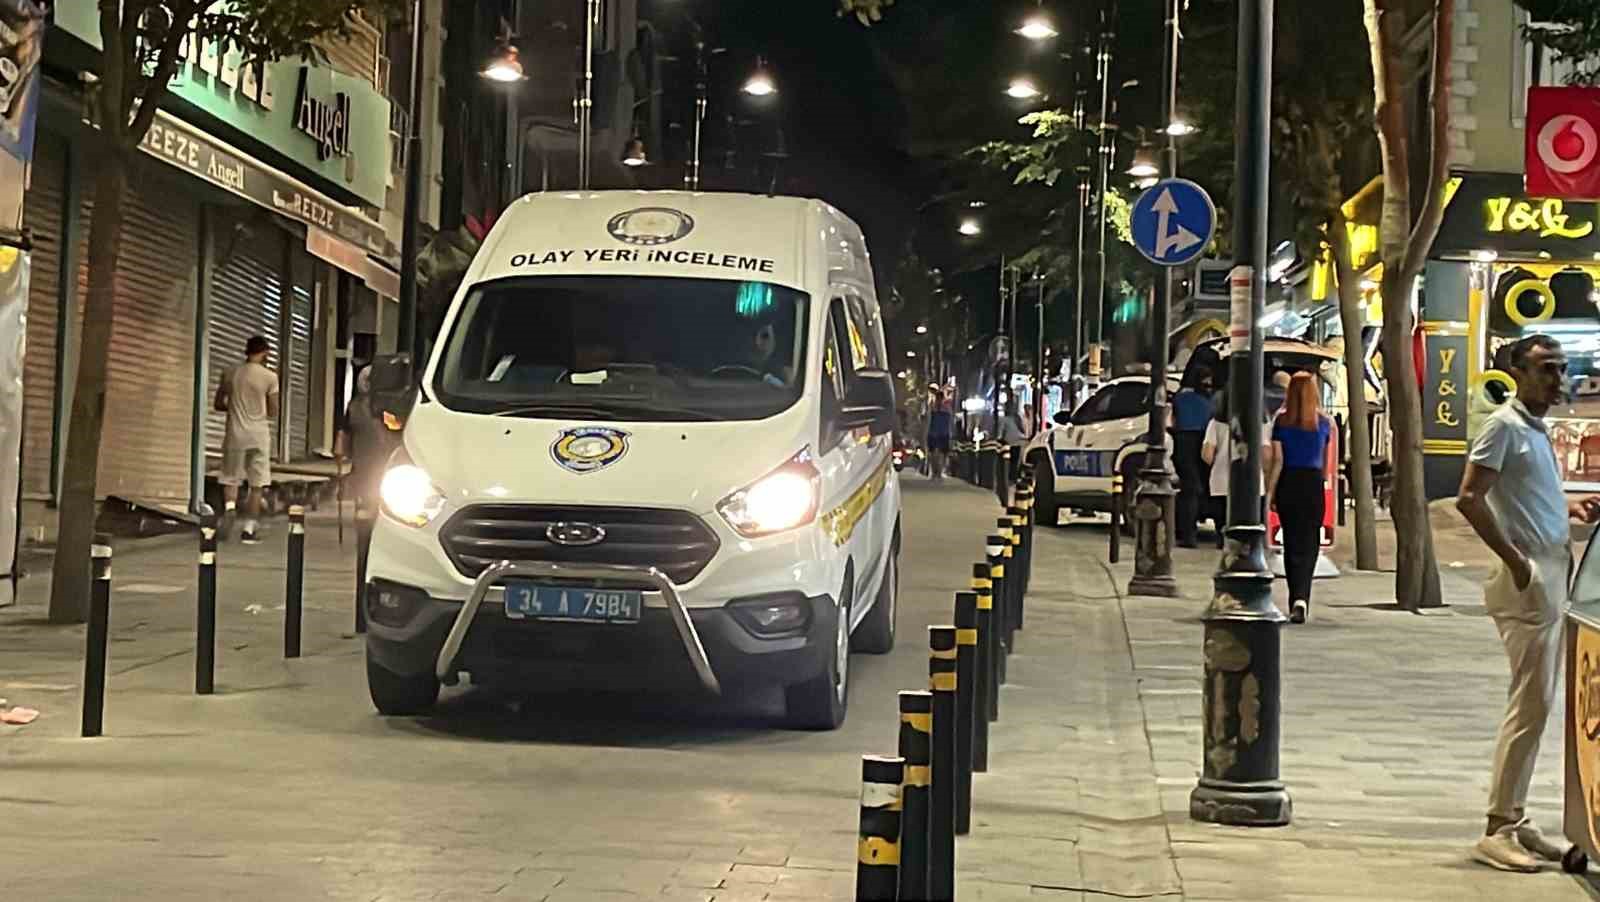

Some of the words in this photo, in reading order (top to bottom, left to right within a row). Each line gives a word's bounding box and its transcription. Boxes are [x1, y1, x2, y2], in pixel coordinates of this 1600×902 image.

[207, 152, 245, 190] Angell
[1487, 197, 1593, 239] Y&G
[510, 249, 575, 267] OLAY
[520, 588, 542, 612] 34
[558, 591, 569, 615] A
[583, 592, 631, 618] 7984
